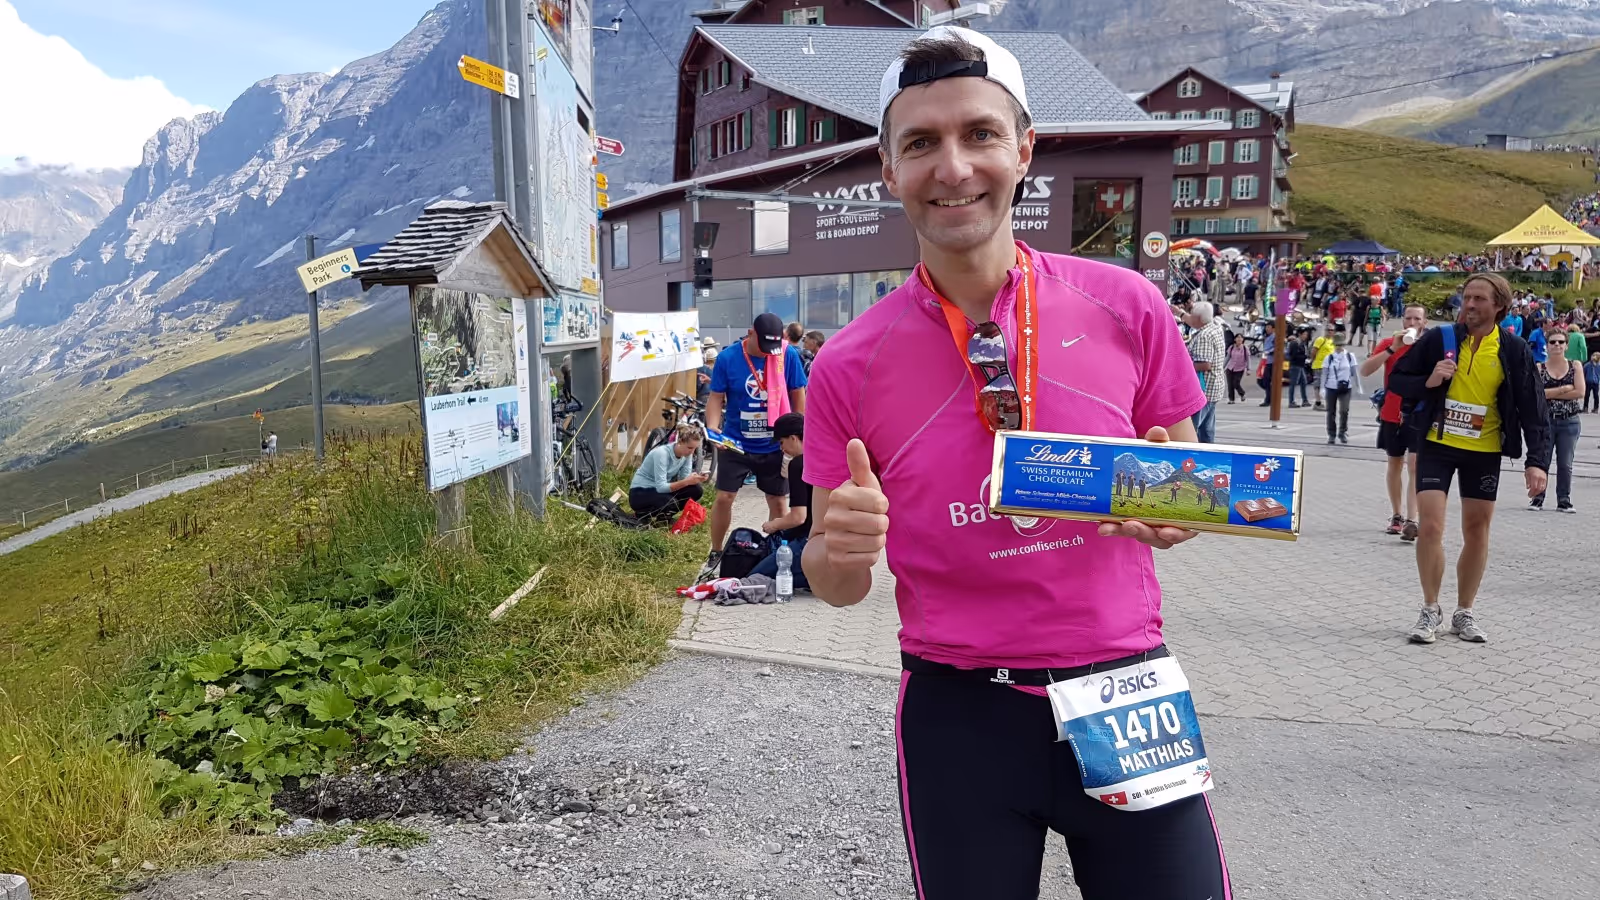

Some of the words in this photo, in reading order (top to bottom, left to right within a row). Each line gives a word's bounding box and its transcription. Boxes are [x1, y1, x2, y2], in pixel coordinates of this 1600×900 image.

[1173, 199, 1220, 208] ALPES
[816, 231, 827, 240] SKI
[833, 228, 856, 238] BOARD
[857, 225, 879, 236] DEPOT
[1012, 220, 1049, 230] DEPOT
[306, 254, 349, 275] Beginners
[312, 271, 333, 286] Park
[1446, 410, 1472, 422] 1110
[1024, 444, 1079, 464] Lindt
[1021, 466, 1048, 475] SWISS
[1050, 468, 1094, 478] PREMIUM
[1028, 475, 1085, 485] CHOCOLATE
[988, 534, 1085, 560] www.confiserie.ch
[1118, 671, 1158, 695] asics
[1104, 701, 1181, 749] 1470
[1118, 738, 1194, 775] MATTHIAS
